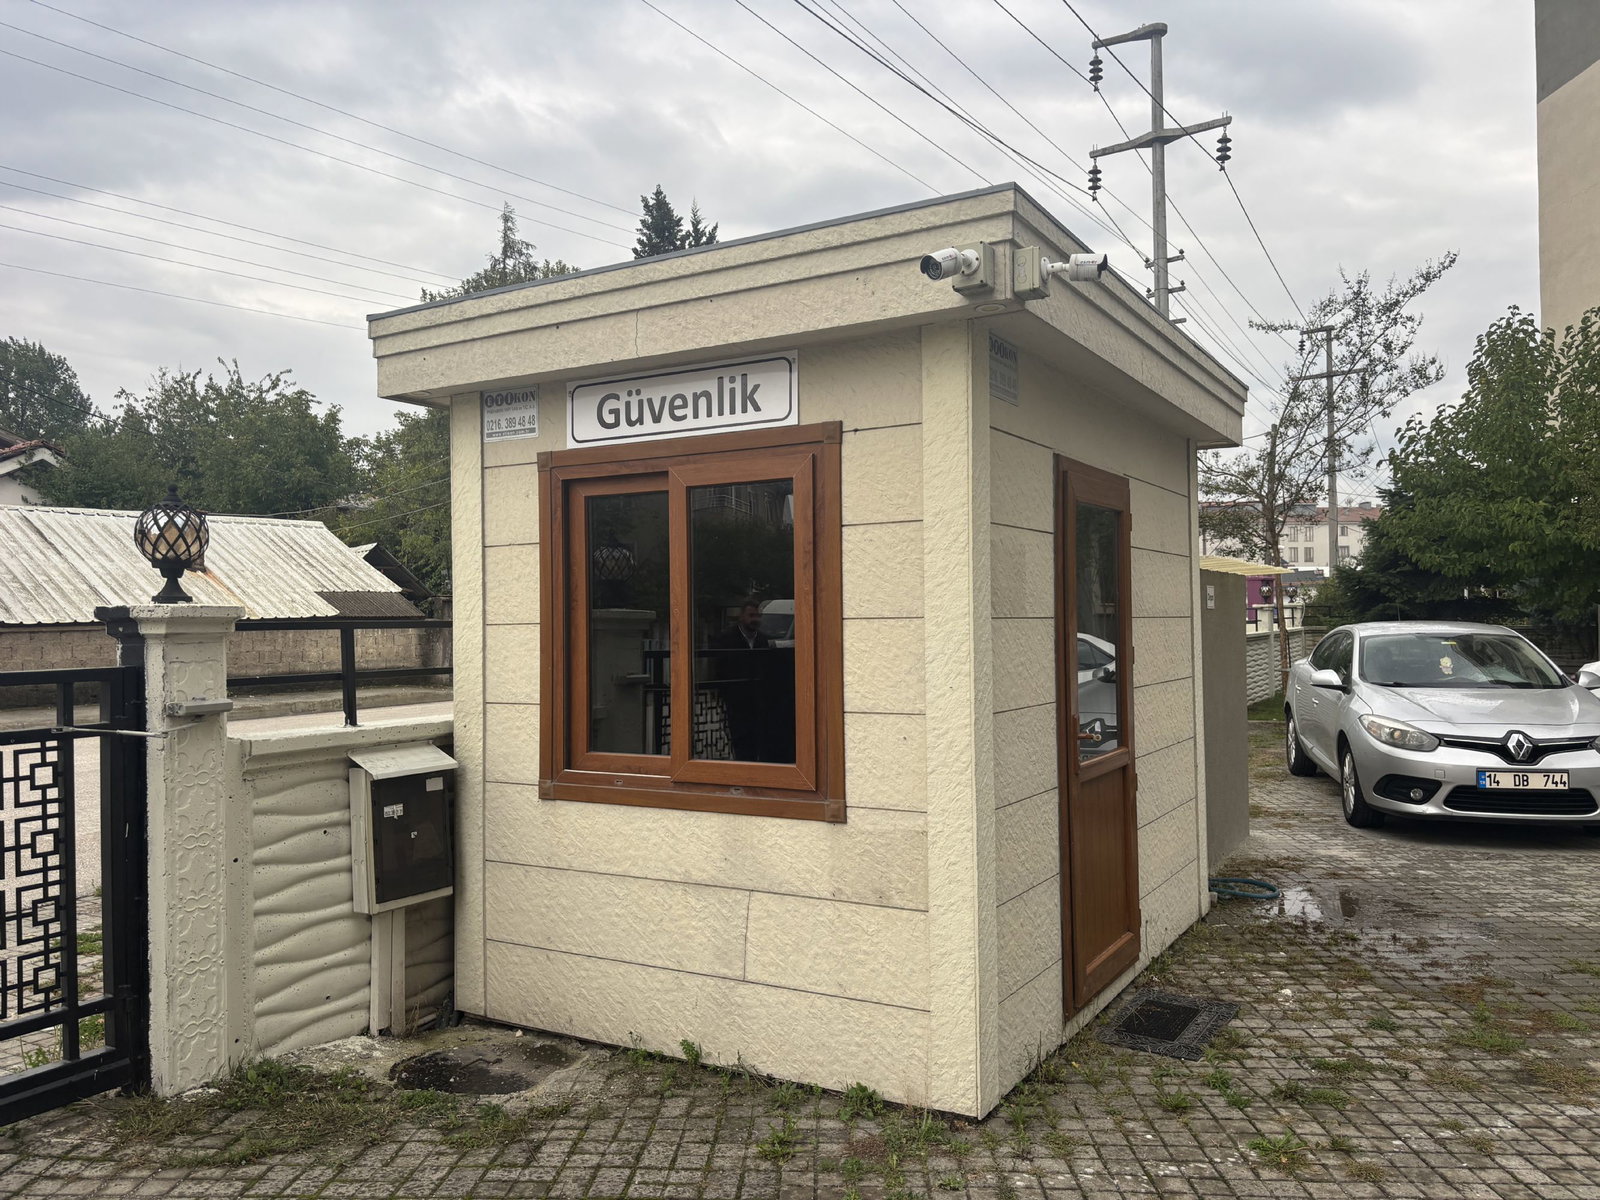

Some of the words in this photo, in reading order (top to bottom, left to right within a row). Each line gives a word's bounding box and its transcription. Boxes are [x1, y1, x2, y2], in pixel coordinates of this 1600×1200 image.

[596, 373, 762, 430] Güvenlik
[505, 417, 516, 429] 389
[518, 415, 526, 427] 48
[528, 414, 535, 426] 48
[1486, 773, 1500, 787] 14
[1513, 774, 1529, 787] DB
[1543, 774, 1567, 787] 744
